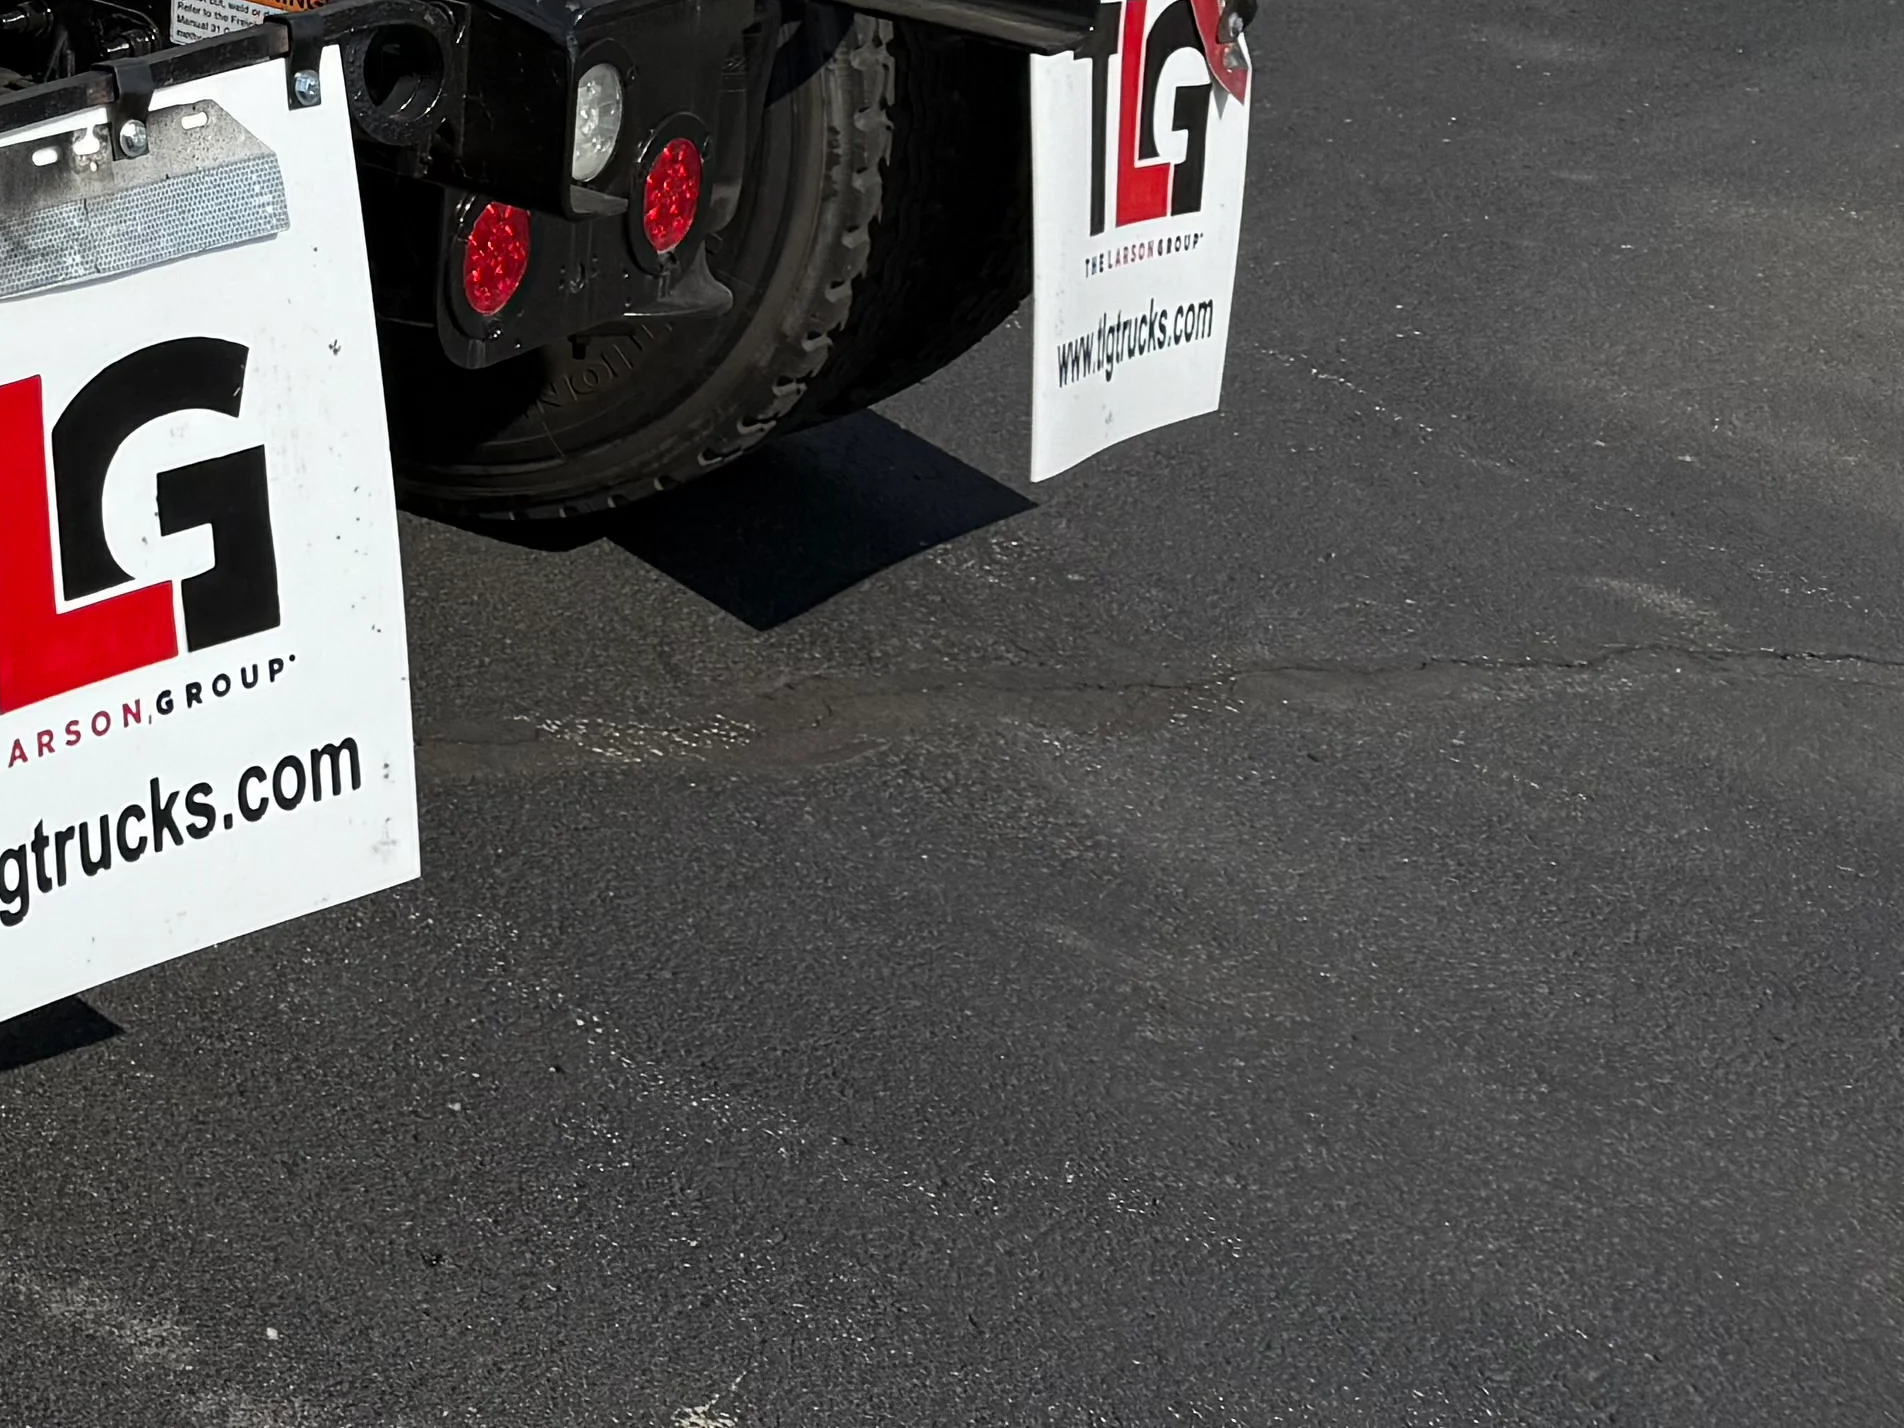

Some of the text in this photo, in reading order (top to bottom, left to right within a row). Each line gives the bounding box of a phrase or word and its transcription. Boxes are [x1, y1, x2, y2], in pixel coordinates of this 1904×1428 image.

[177, 1, 201, 14] Refer
[202, 8, 212, 18] to
[214, 11, 229, 22] the
[177, 13, 209, 31] Manual
[1084, 232, 1204, 279] THE LARSON GROUP
[1056, 292, 1213, 389] www.tlgtrucks.com
[153, 653, 298, 718] GROUP
